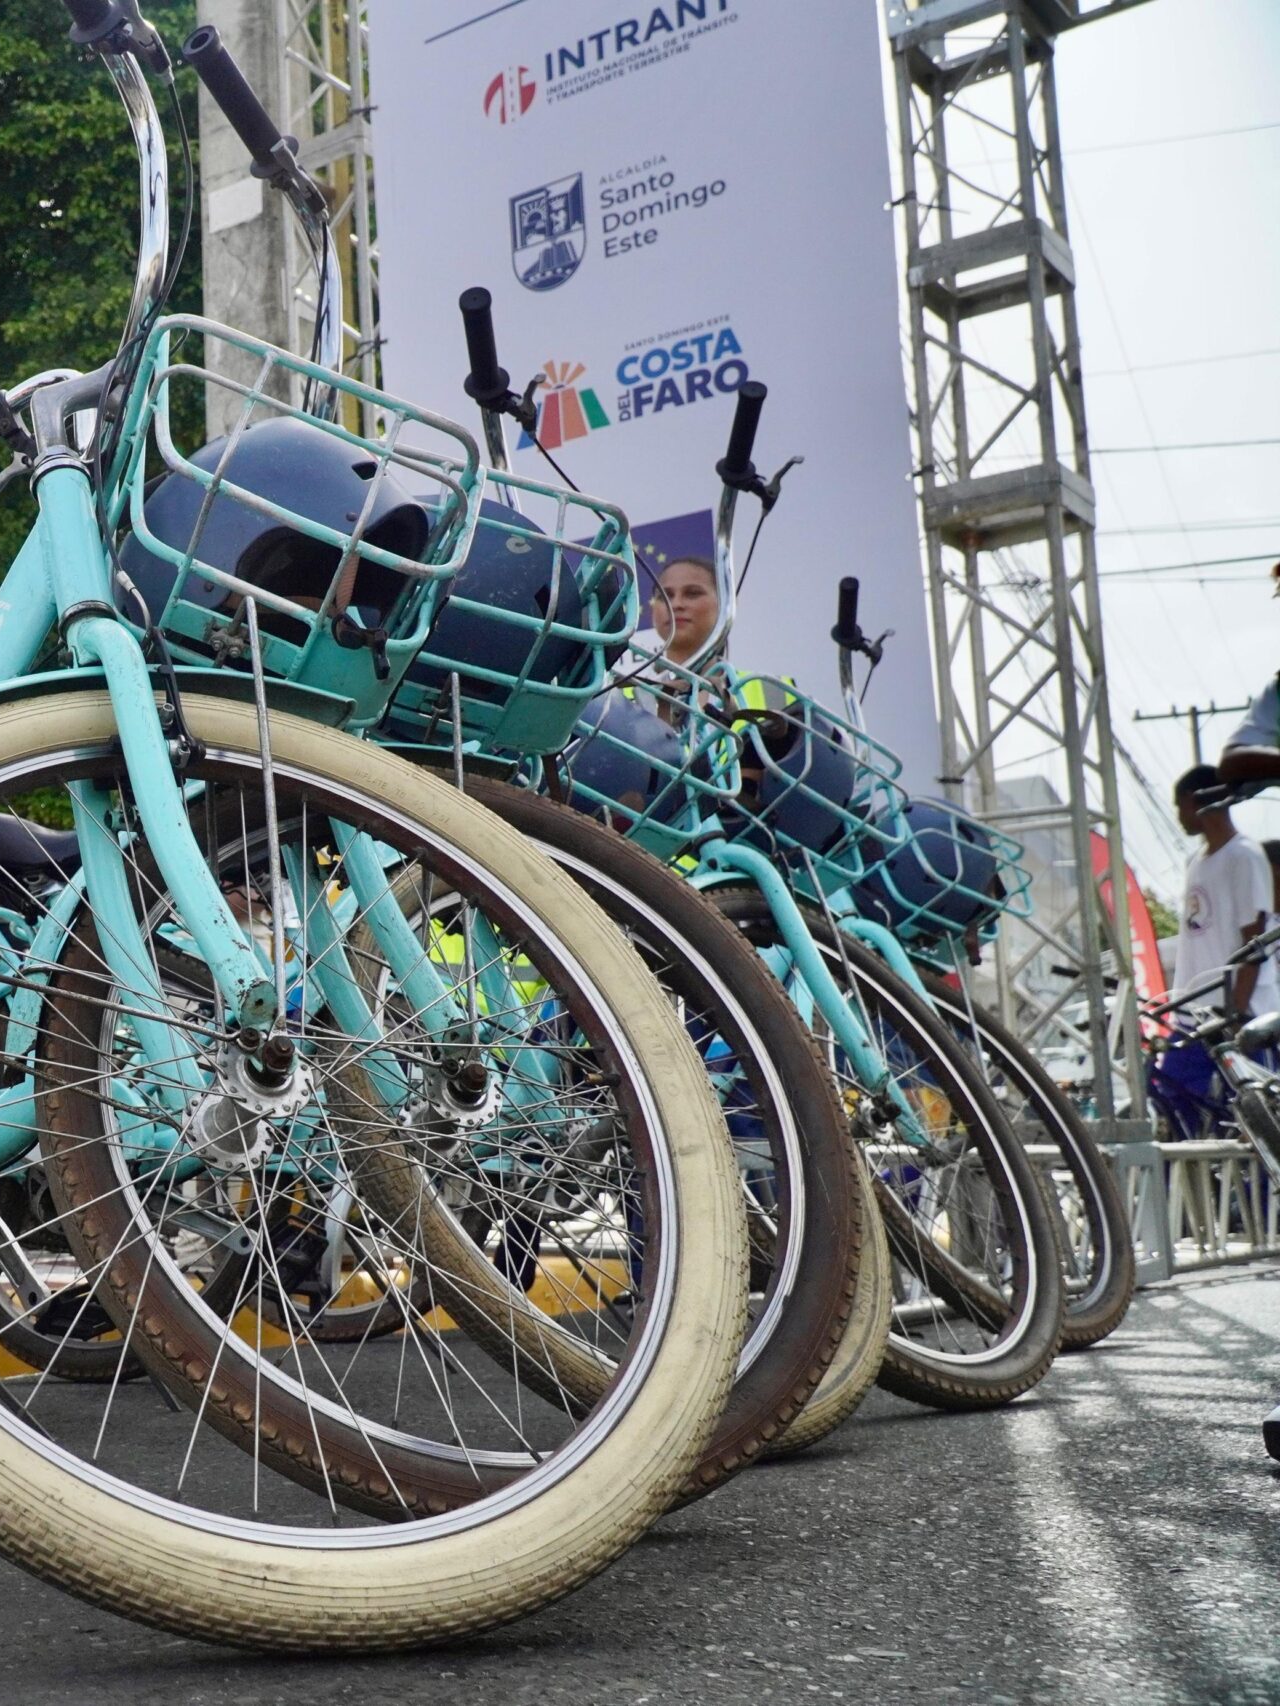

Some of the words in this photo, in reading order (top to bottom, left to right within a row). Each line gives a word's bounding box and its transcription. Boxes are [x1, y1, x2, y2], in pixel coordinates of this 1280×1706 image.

[546, 68, 601, 96] INSTITUTO
[603, 43, 659, 74] NACIONAL
[663, 35, 677, 49] DE
[546, 96, 554, 105] Y
[556, 68, 625, 102] TRANSPORTE
[600, 154, 667, 185] ALCALDÍA
[600, 171, 675, 210] Santo
[602, 179, 726, 234] Domingo
[603, 228, 658, 258] Este
[624, 335, 656, 351] SANTO
[658, 321, 705, 341] DOMINGO
[616, 326, 742, 387] COSTA
[617, 388, 631, 423] DEL
[631, 358, 749, 418] FARO
